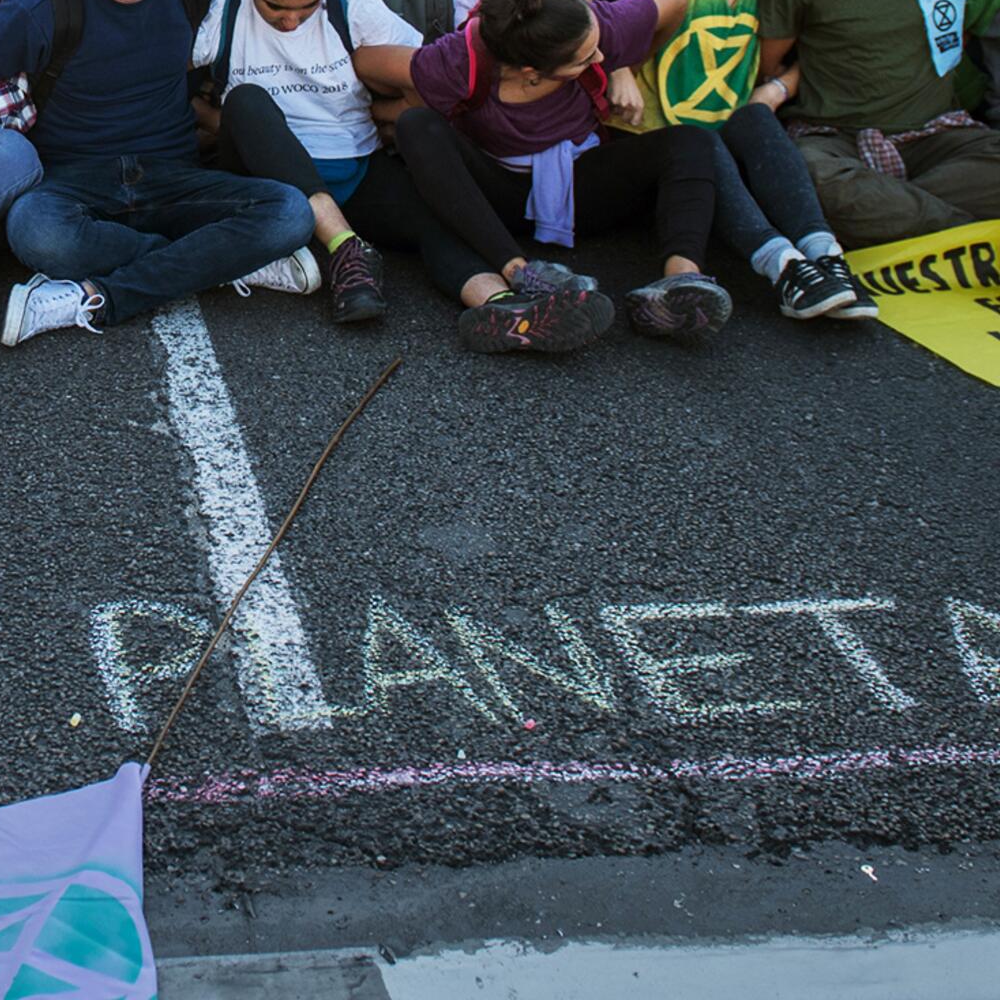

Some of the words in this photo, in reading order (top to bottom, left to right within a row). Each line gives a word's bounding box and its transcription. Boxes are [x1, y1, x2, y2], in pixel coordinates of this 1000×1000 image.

[247, 65, 281, 76] beauty
[284, 64, 294, 72] is
[311, 63, 328, 75] the
[281, 83, 319, 94] WOCO
